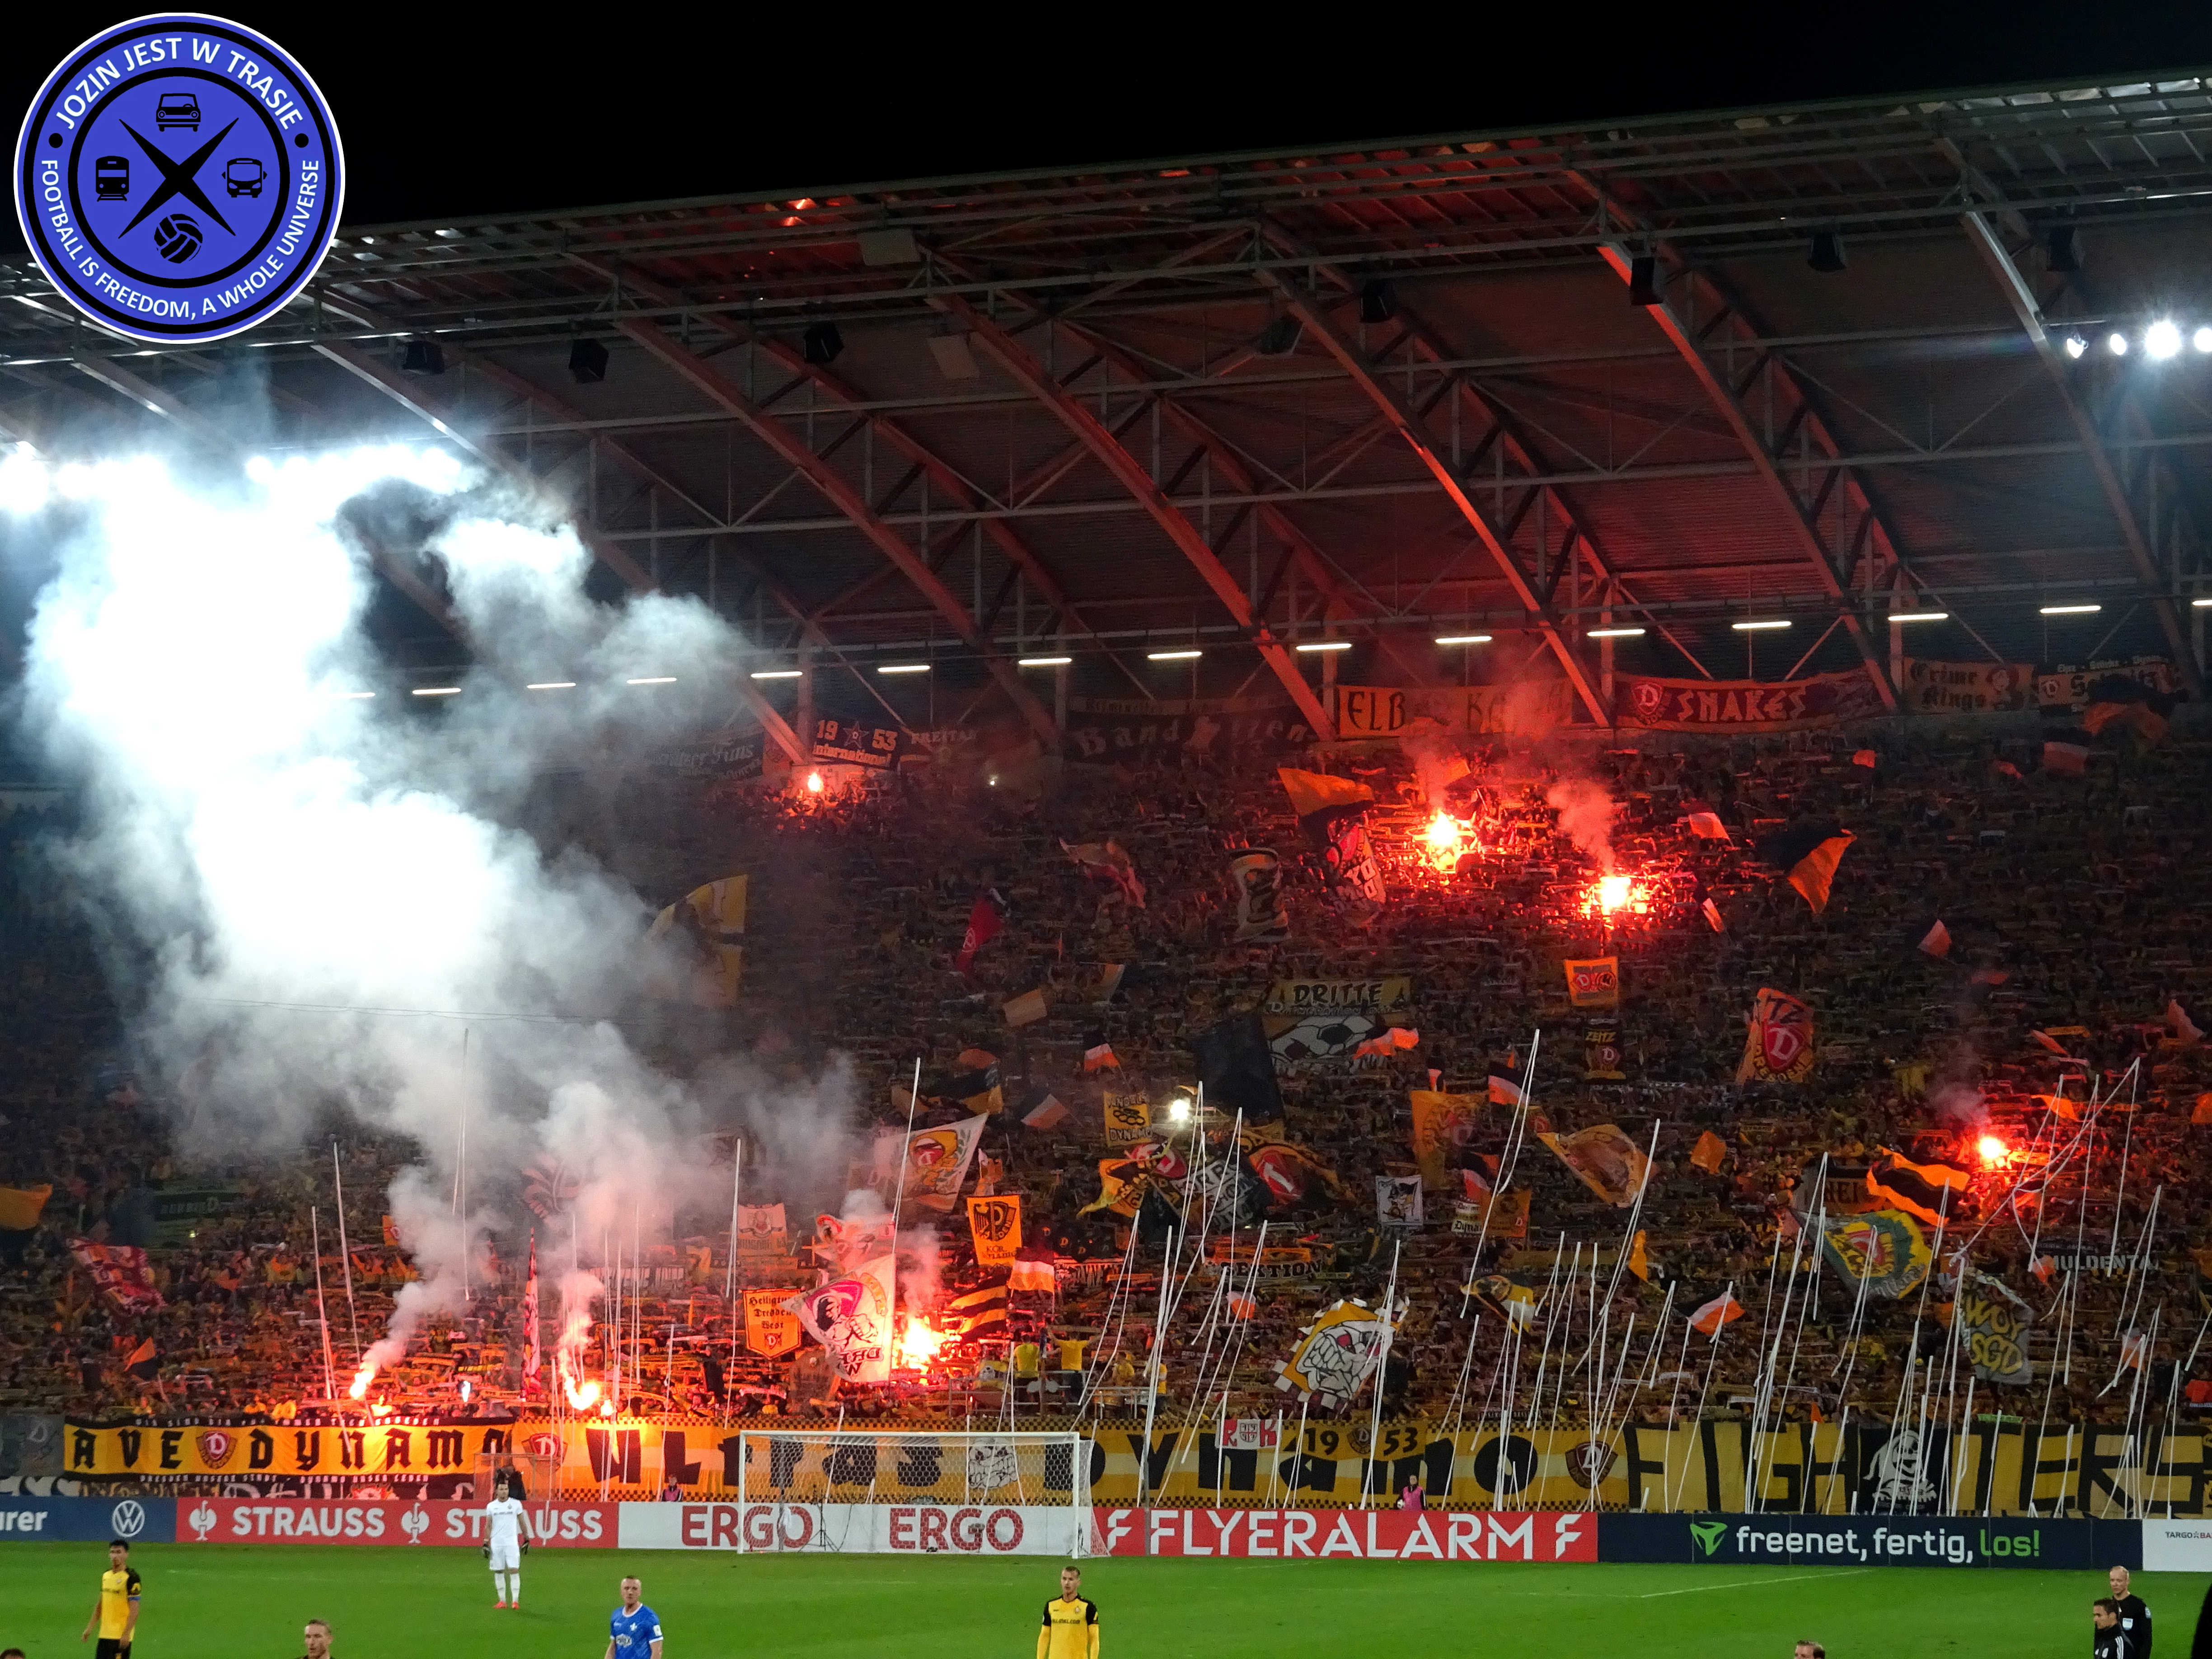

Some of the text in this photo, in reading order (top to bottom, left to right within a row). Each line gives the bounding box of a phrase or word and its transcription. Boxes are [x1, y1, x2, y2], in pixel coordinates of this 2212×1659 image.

[1678, 687, 1806, 722] SNAKES
[816, 720, 898, 751] 19 53
[1293, 982, 1383, 1004] DRITTE
[1109, 1126, 1153, 1141] DYNAMO
[73, 1428, 184, 1470] AVE
[1304, 1427, 1340, 1455] 19
[1383, 1425, 1419, 1456] 53
[232, 1506, 385, 1537] STRAUSS
[445, 1508, 603, 1540] STAUSS
[681, 1505, 813, 1549] ERGO
[889, 1507, 1024, 1551] ERGO
[1150, 1509, 1534, 1560] FLYERALARM
[1736, 1525, 2040, 1563] freenet, fertig, los!
